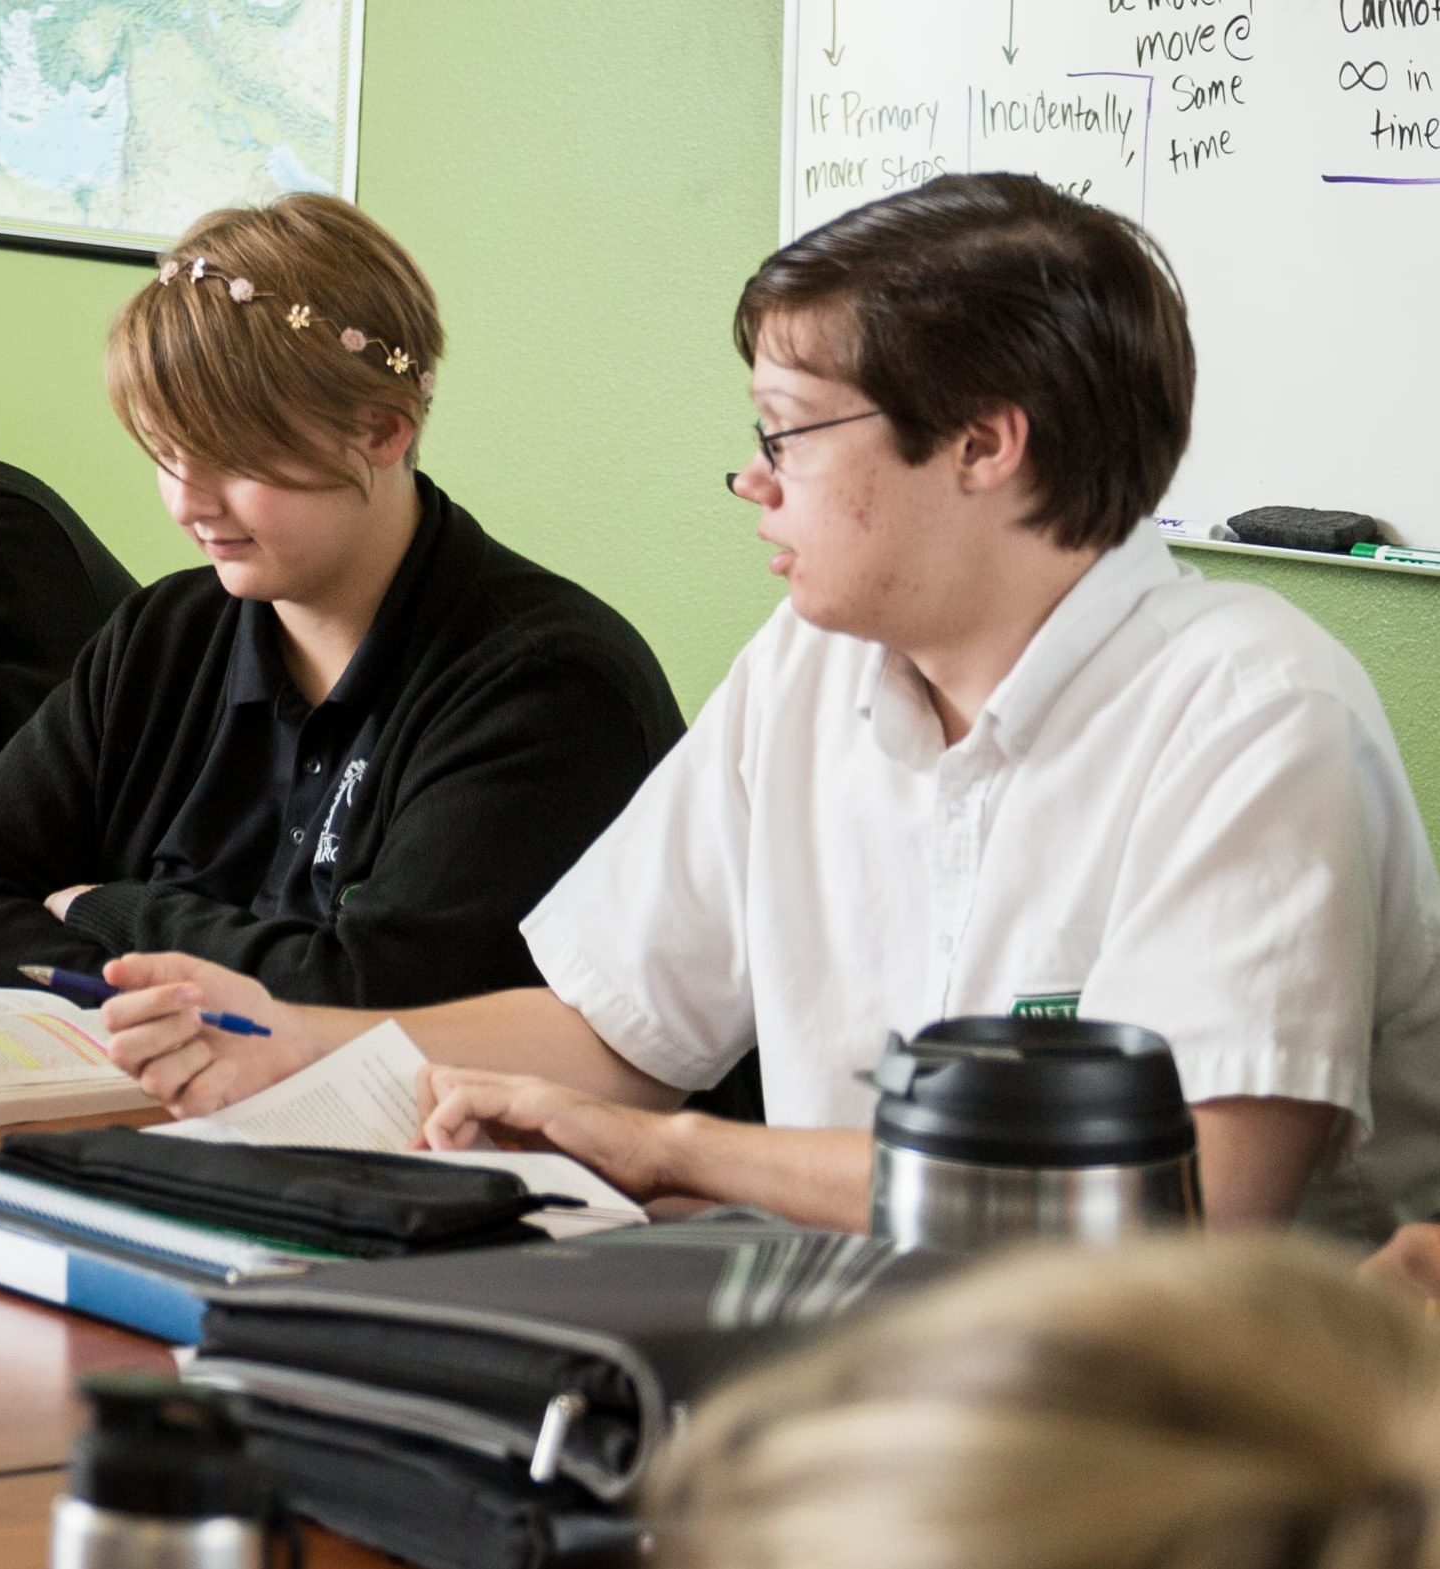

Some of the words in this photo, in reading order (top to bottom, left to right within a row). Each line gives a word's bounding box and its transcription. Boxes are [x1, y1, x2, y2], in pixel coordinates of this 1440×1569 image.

[1137, 24, 1215, 68] move
[1407, 59, 1433, 91] in
[841, 90, 938, 150] Primary
[1370, 109, 1440, 150] time
[1168, 130, 1235, 174] time
[806, 157, 869, 199] mover
